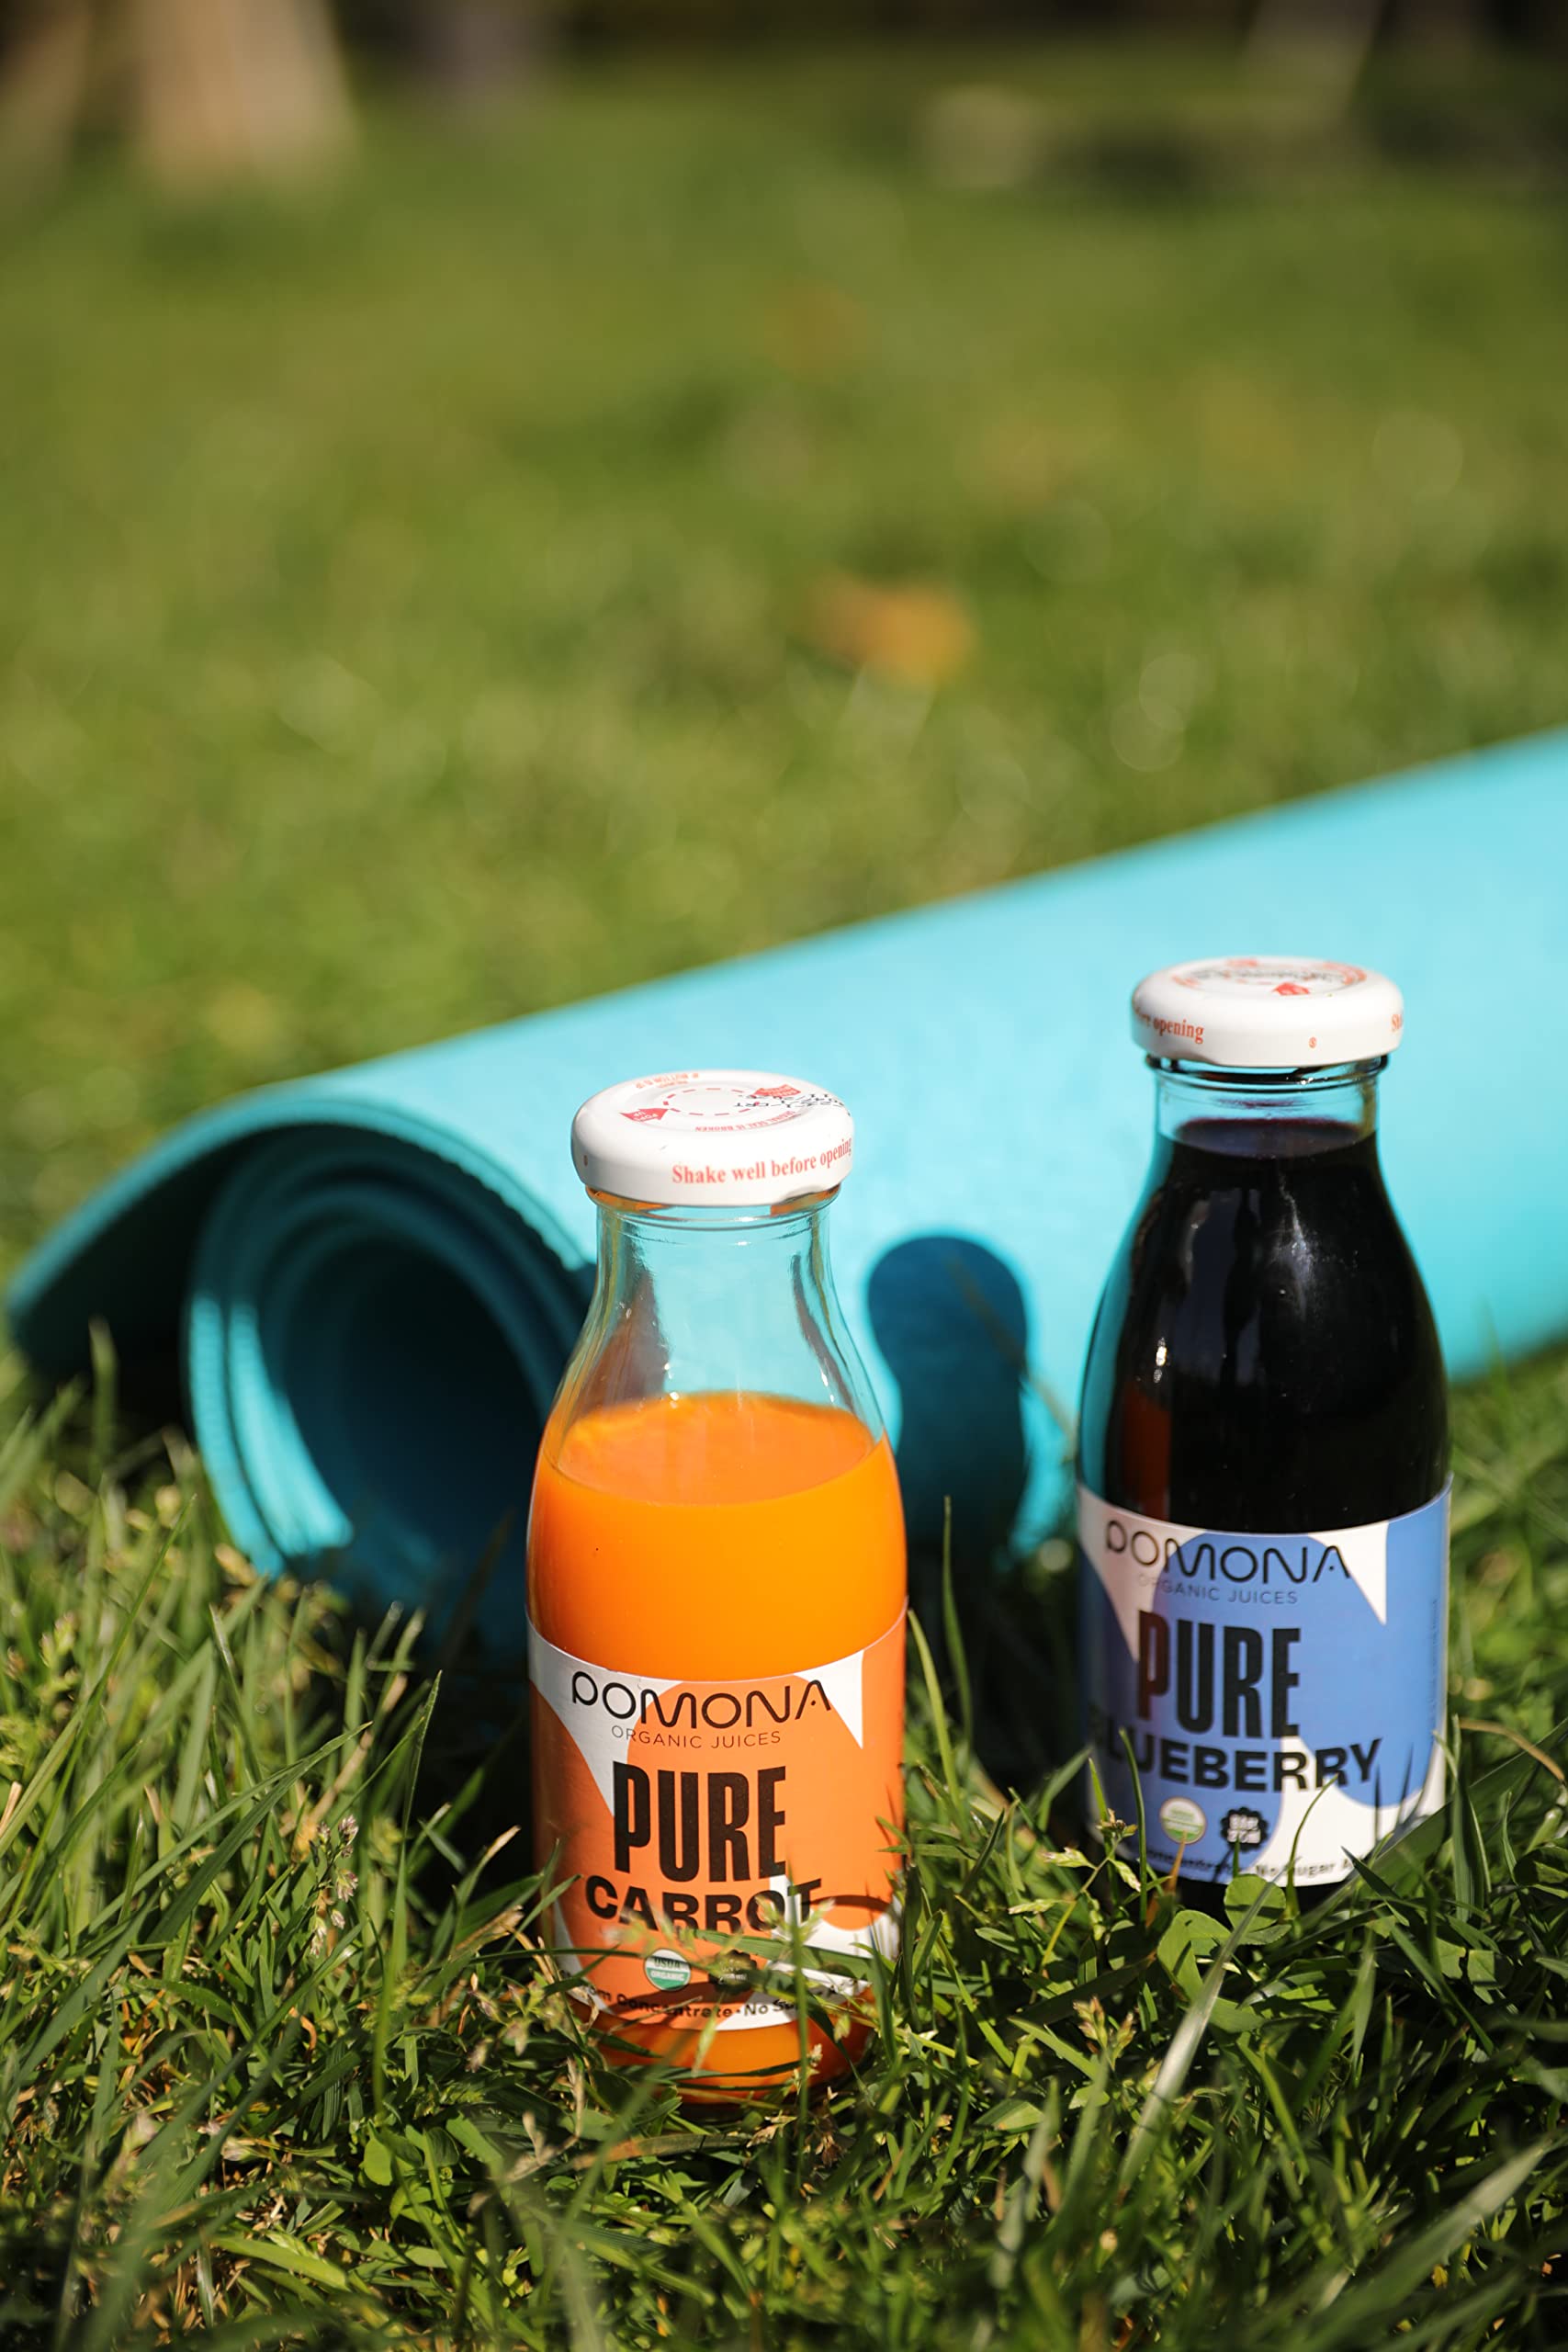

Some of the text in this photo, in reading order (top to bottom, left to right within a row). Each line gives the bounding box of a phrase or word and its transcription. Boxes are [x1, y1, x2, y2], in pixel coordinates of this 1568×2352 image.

[1153, 1018, 1204, 1044] opening
[672, 1136, 852, 1183] Shake well before opening
[1106, 1520, 1350, 1584] POMONA
[1139, 1572, 1298, 1605] ORGANIC JUICES
[1138, 1609, 1301, 1738] PURE
[572, 1670, 831, 1729] POMONA
[611, 1724, 782, 1749] ORGANIC JUICES
[613, 1760, 786, 1883] PURE
[1288, 1860, 1336, 1878] ugar
[585, 1874, 822, 1933] CARROT
[744, 2003, 768, 2017] No
